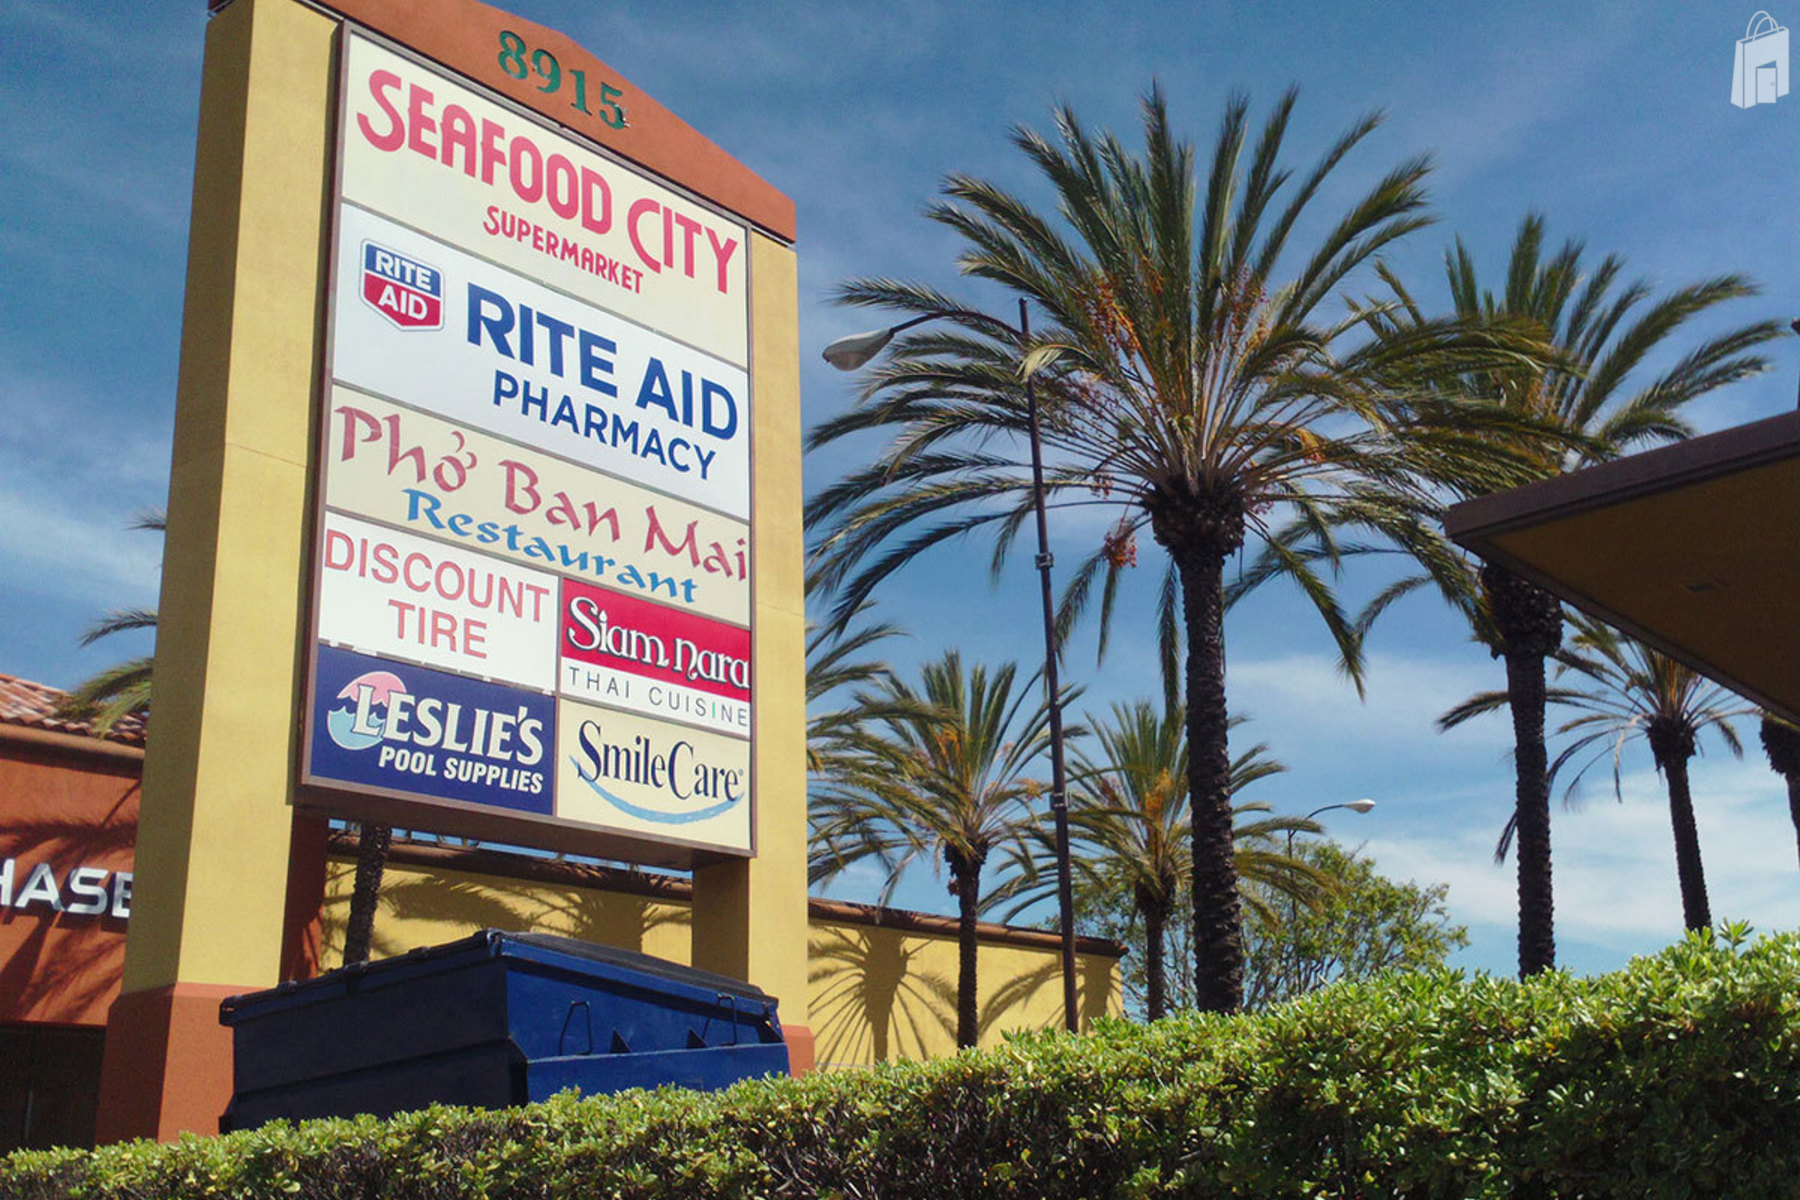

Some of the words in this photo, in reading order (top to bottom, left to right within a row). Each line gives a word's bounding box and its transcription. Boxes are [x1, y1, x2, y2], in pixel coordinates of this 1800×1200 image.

[498, 30, 629, 129] 8915
[357, 69, 612, 235] SEAFOOD
[627, 198, 738, 294] CITY
[375, 251, 431, 289] RITE
[483, 205, 643, 294] SUPERMARKET
[378, 285, 428, 321] AID
[467, 282, 617, 398] RITE
[635, 357, 738, 441] AID
[495, 370, 715, 480] PHARMACY
[402, 488, 698, 603] Restaurant
[498, 460, 620, 542] Ban
[644, 505, 746, 581] Mai
[324, 529, 550, 623] DISCOUNT
[388, 599, 488, 659] TIRE
[567, 597, 669, 667] Siam
[352, 684, 543, 765] LESLIE'S
[569, 666, 629, 698] THAI
[649, 686, 748, 727] CUISINE
[378, 746, 437, 777] POOL
[443, 757, 543, 795] SUPPLIES
